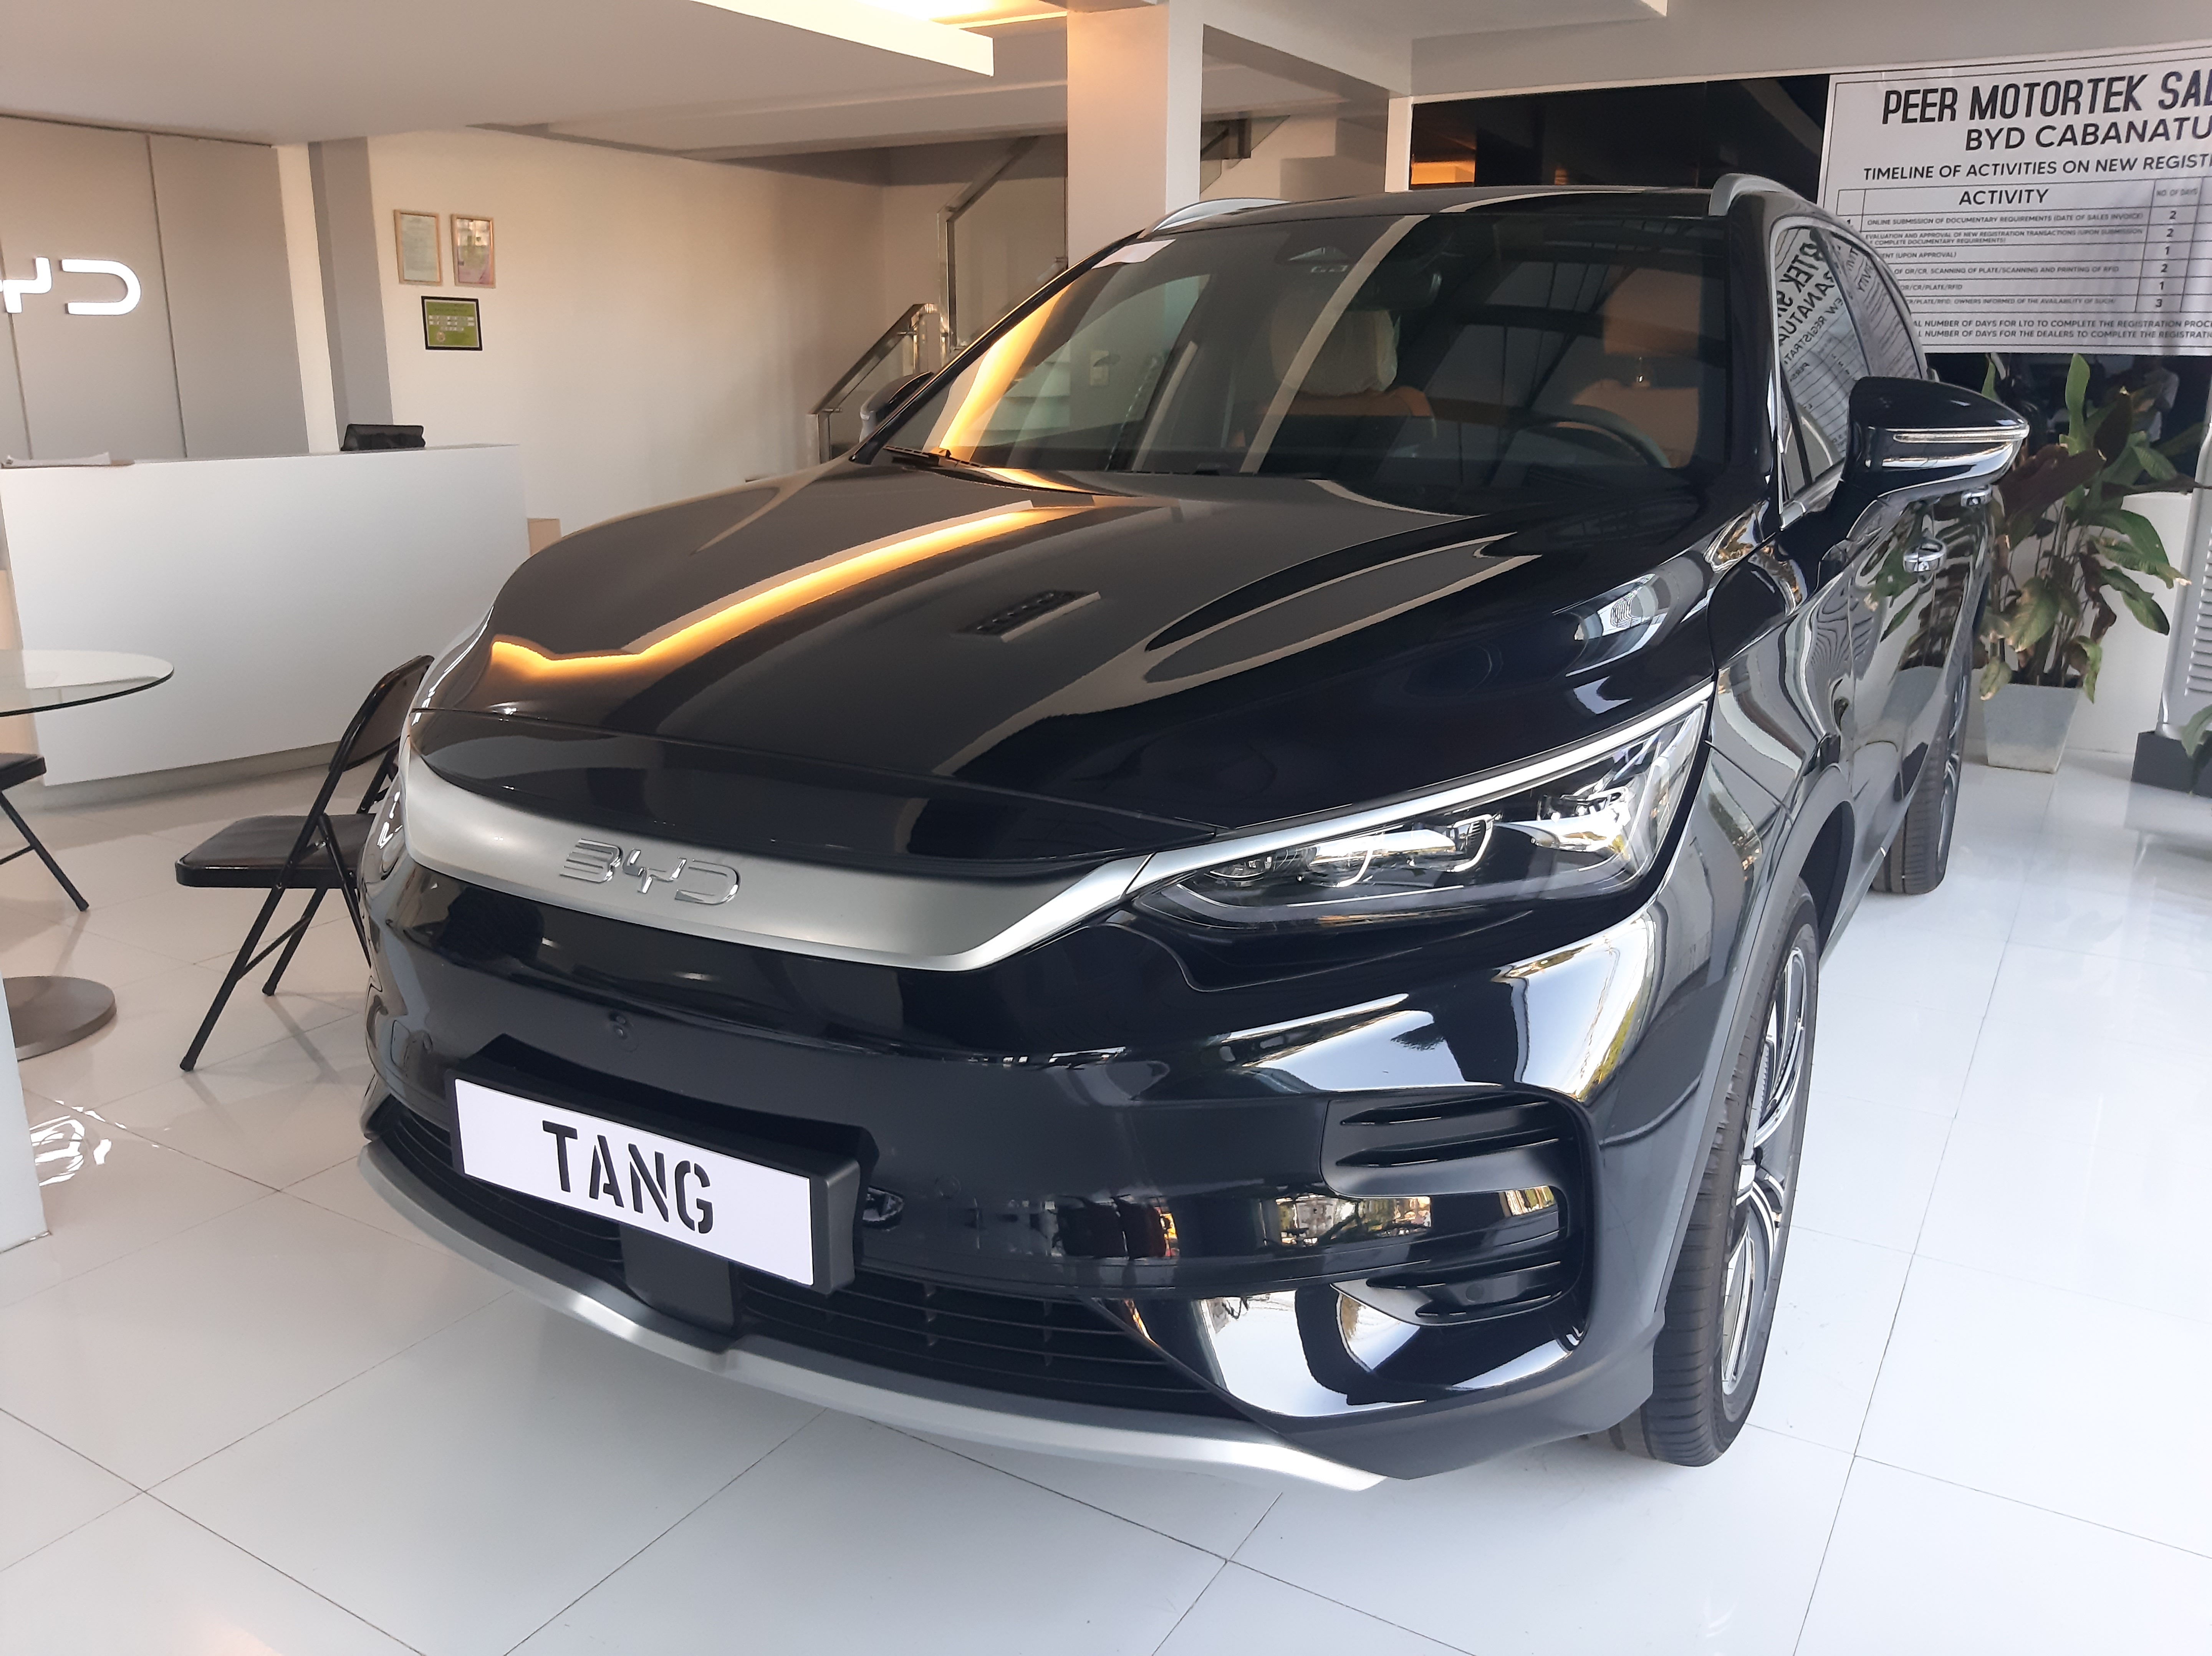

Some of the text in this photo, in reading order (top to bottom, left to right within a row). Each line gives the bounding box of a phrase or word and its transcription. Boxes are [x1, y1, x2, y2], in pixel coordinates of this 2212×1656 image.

[1882, 87, 1958, 124] PEER
[1969, 75, 2148, 120] MOTORTEK
[1965, 116, 2212, 151] BYD CABANATU
[1864, 166, 1934, 180] TIMELINE
[1939, 165, 1961, 178] OF
[1966, 161, 2057, 177] ACTIVITIES
[2063, 160, 2090, 173] ON
[2095, 157, 2138, 172] NEW
[1959, 188, 2049, 205] ACTIVITY
[2170, 210, 2176, 219] 2
[2166, 229, 2174, 237] 2
[2165, 246, 2169, 255] 1
[2161, 264, 2168, 273] 2
[2160, 281, 2164, 290] 1
[2156, 299, 2162, 308] 3
[560, 838, 741, 906] BYD
[542, 1119, 714, 1234] TANG
